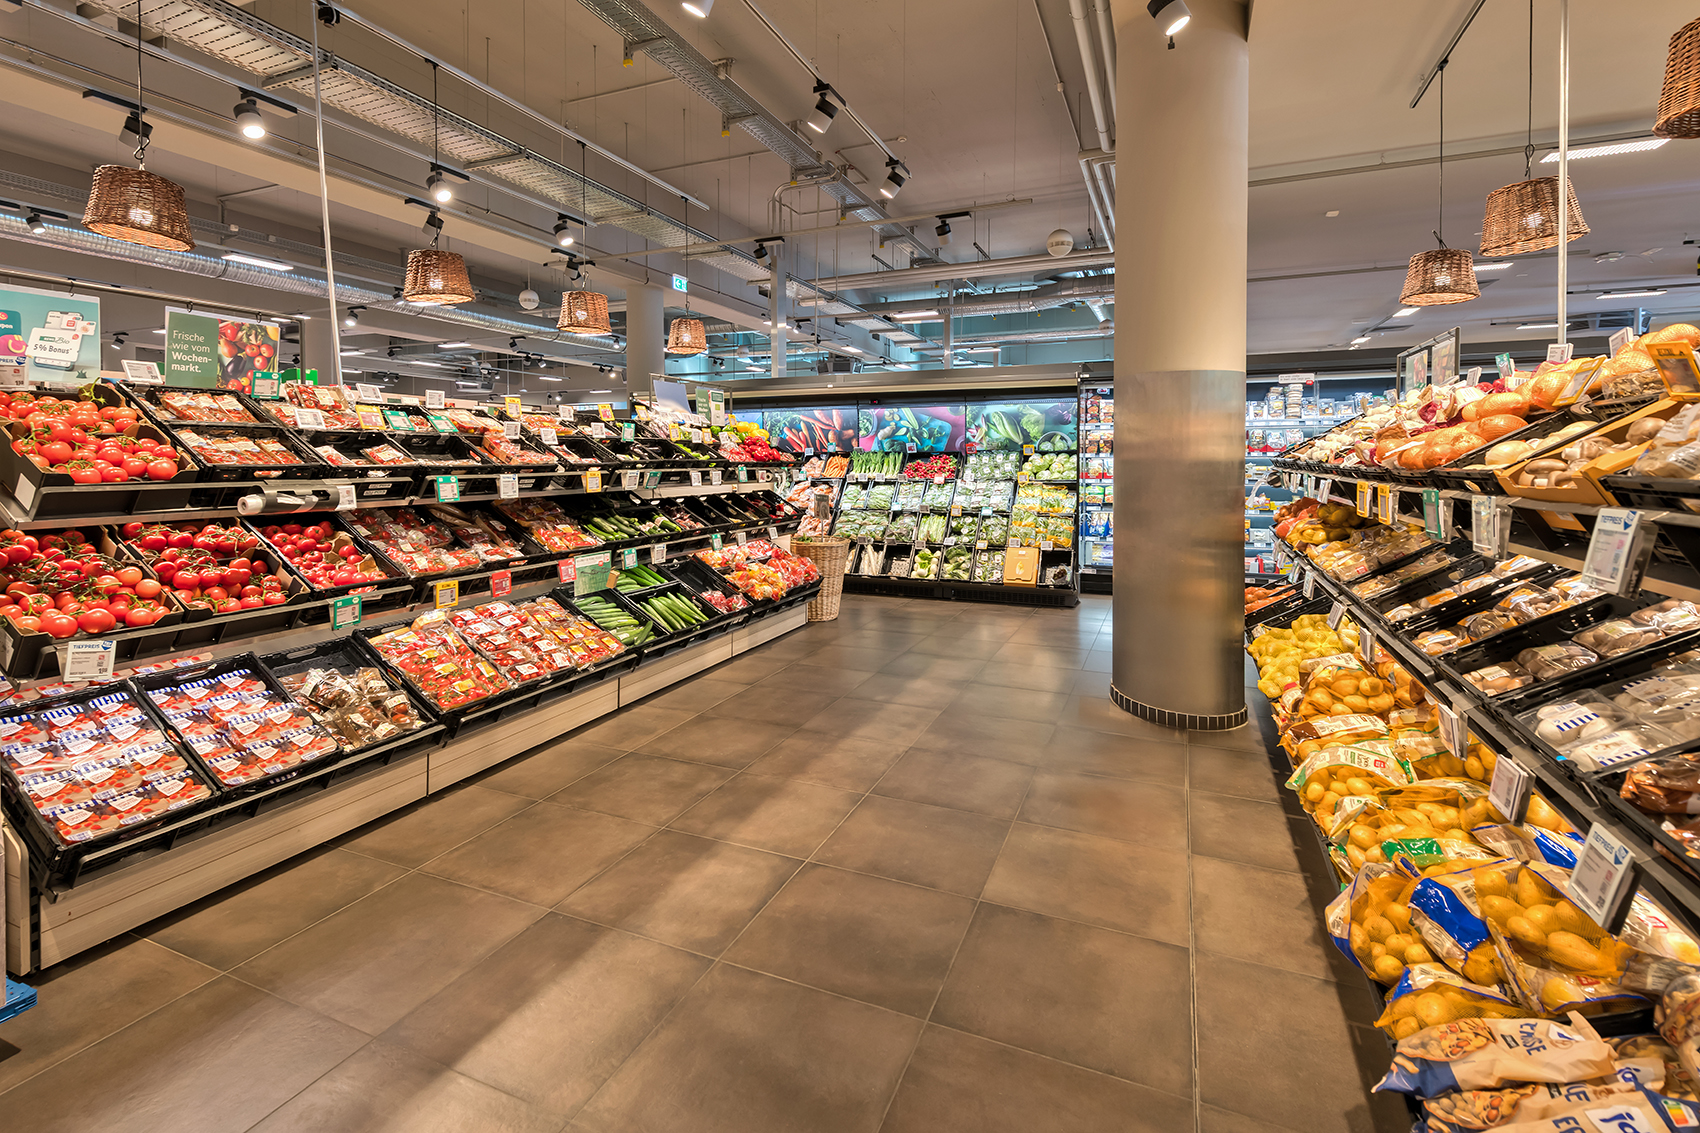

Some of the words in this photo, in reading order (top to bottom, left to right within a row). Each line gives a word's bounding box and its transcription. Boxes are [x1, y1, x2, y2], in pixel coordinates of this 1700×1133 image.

[173, 330, 204, 342] Frische
[172, 342, 188, 350] wie
[192, 344, 210, 353] vom
[172, 351, 212, 363] Wochen-
[172, 363, 202, 373] markt.
